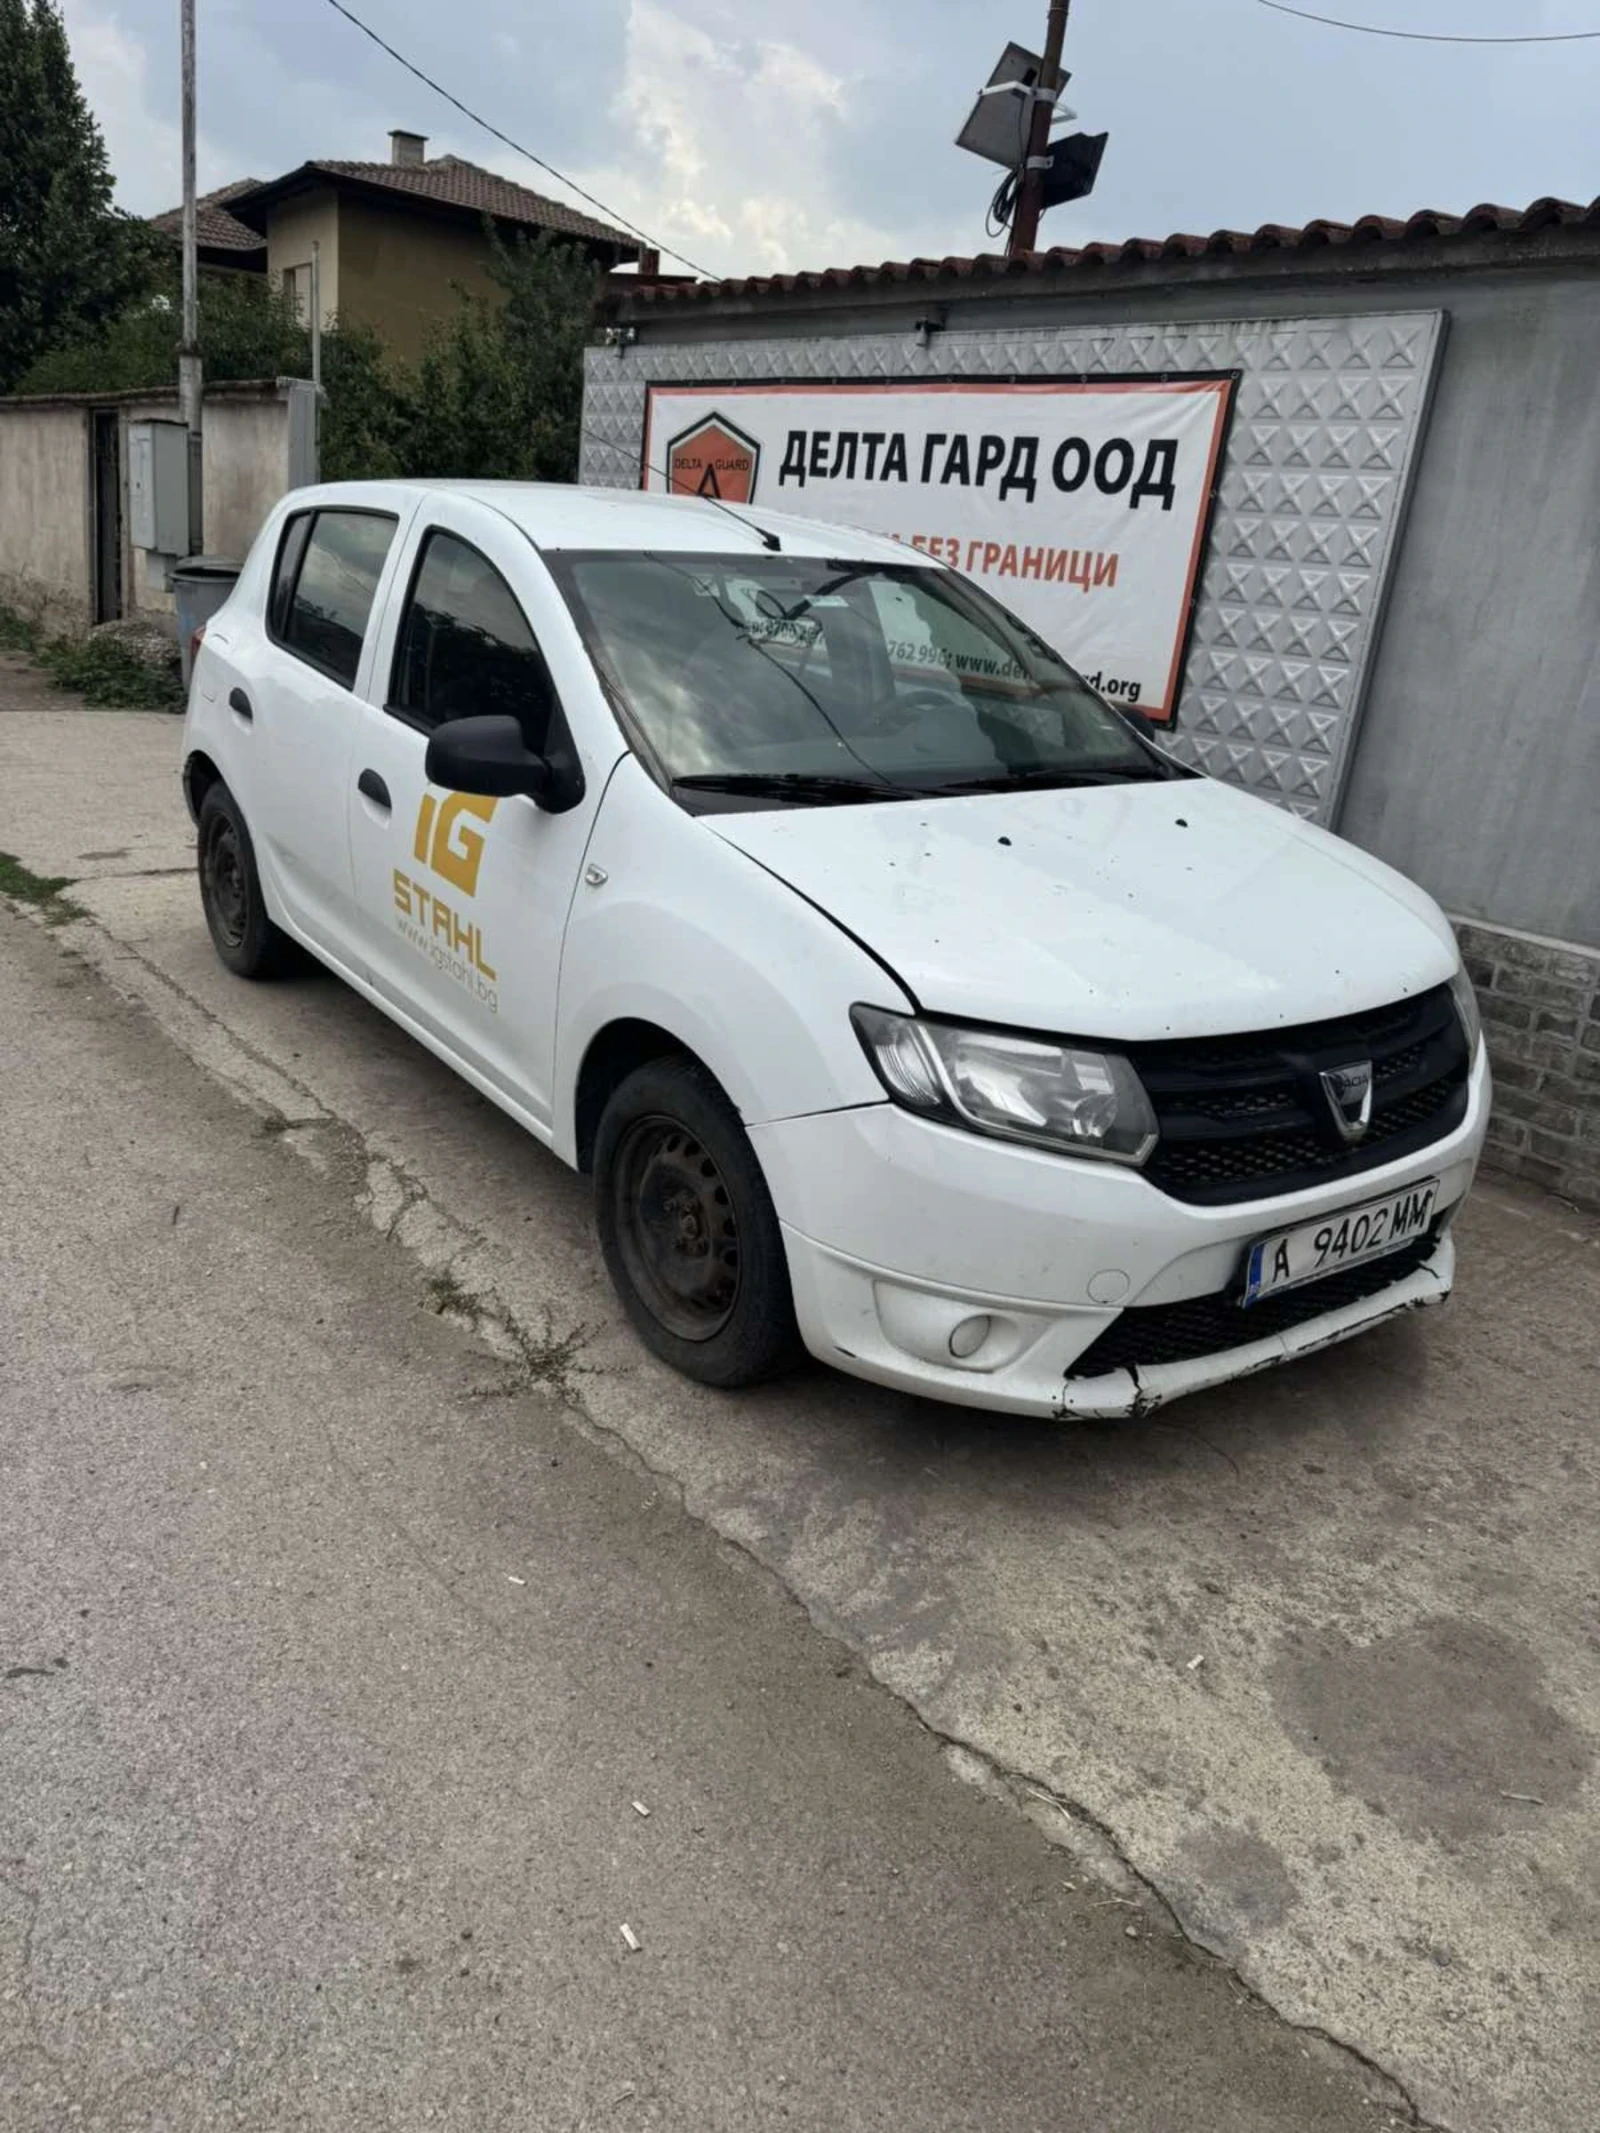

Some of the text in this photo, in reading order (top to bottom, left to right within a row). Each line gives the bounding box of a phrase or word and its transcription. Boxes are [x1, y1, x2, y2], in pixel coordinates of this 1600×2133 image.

[674, 458, 749, 472] DELTA GUARD
[779, 430, 1179, 511] ДЕЛТА ГАРД ООД
[965, 540, 1119, 593] ГРАНИЦИ
[414, 791, 500, 898] IG
[393, 868, 497, 982] STAHL
[1313, 1208, 1388, 1268] 9402
